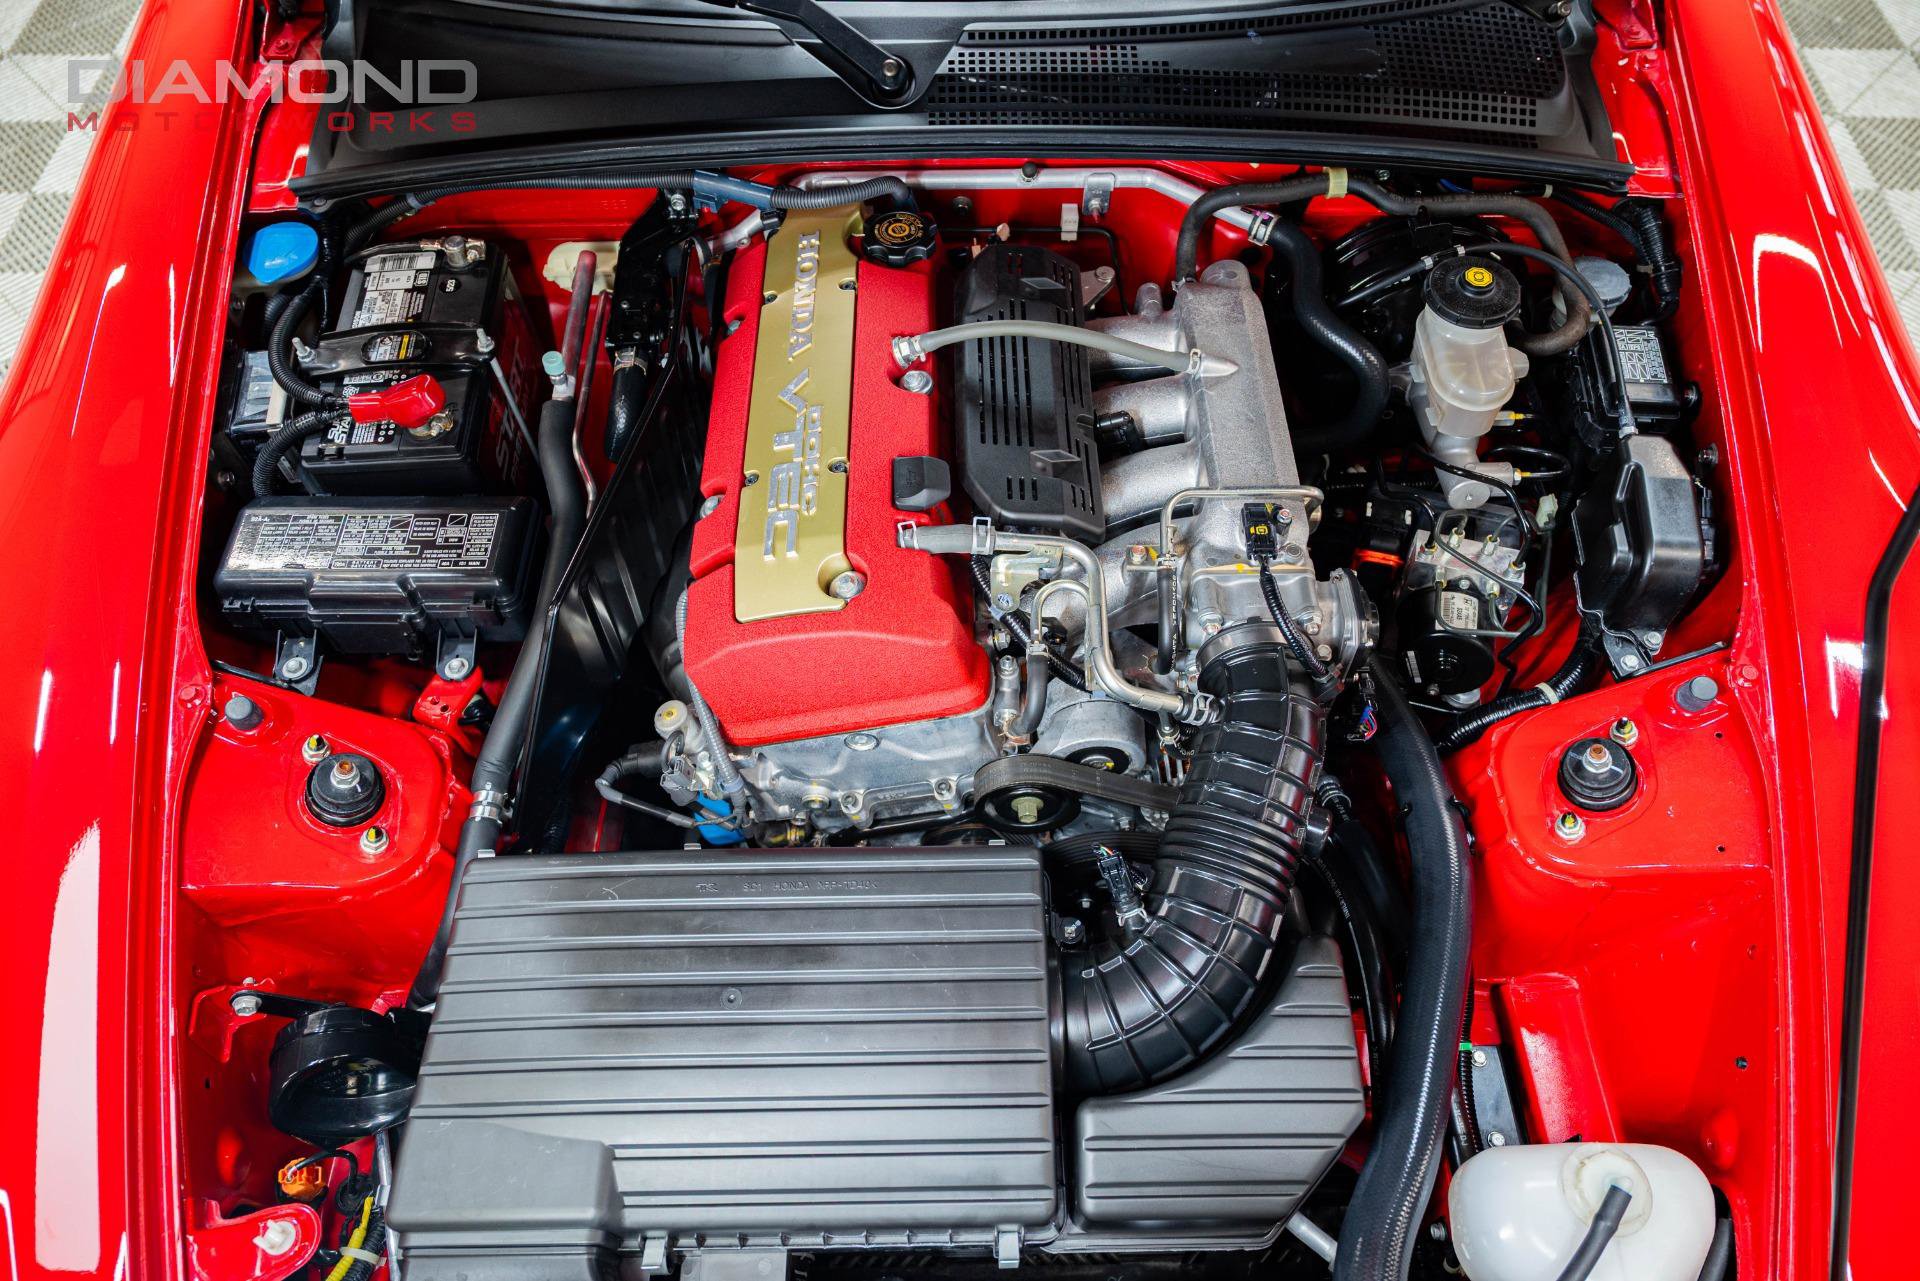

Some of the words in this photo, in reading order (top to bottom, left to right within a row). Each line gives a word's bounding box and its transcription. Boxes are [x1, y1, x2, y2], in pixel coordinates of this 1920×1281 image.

[788, 230, 820, 362] HONDA
[762, 367, 809, 562] VTEC
[801, 403, 824, 517] DOHC
